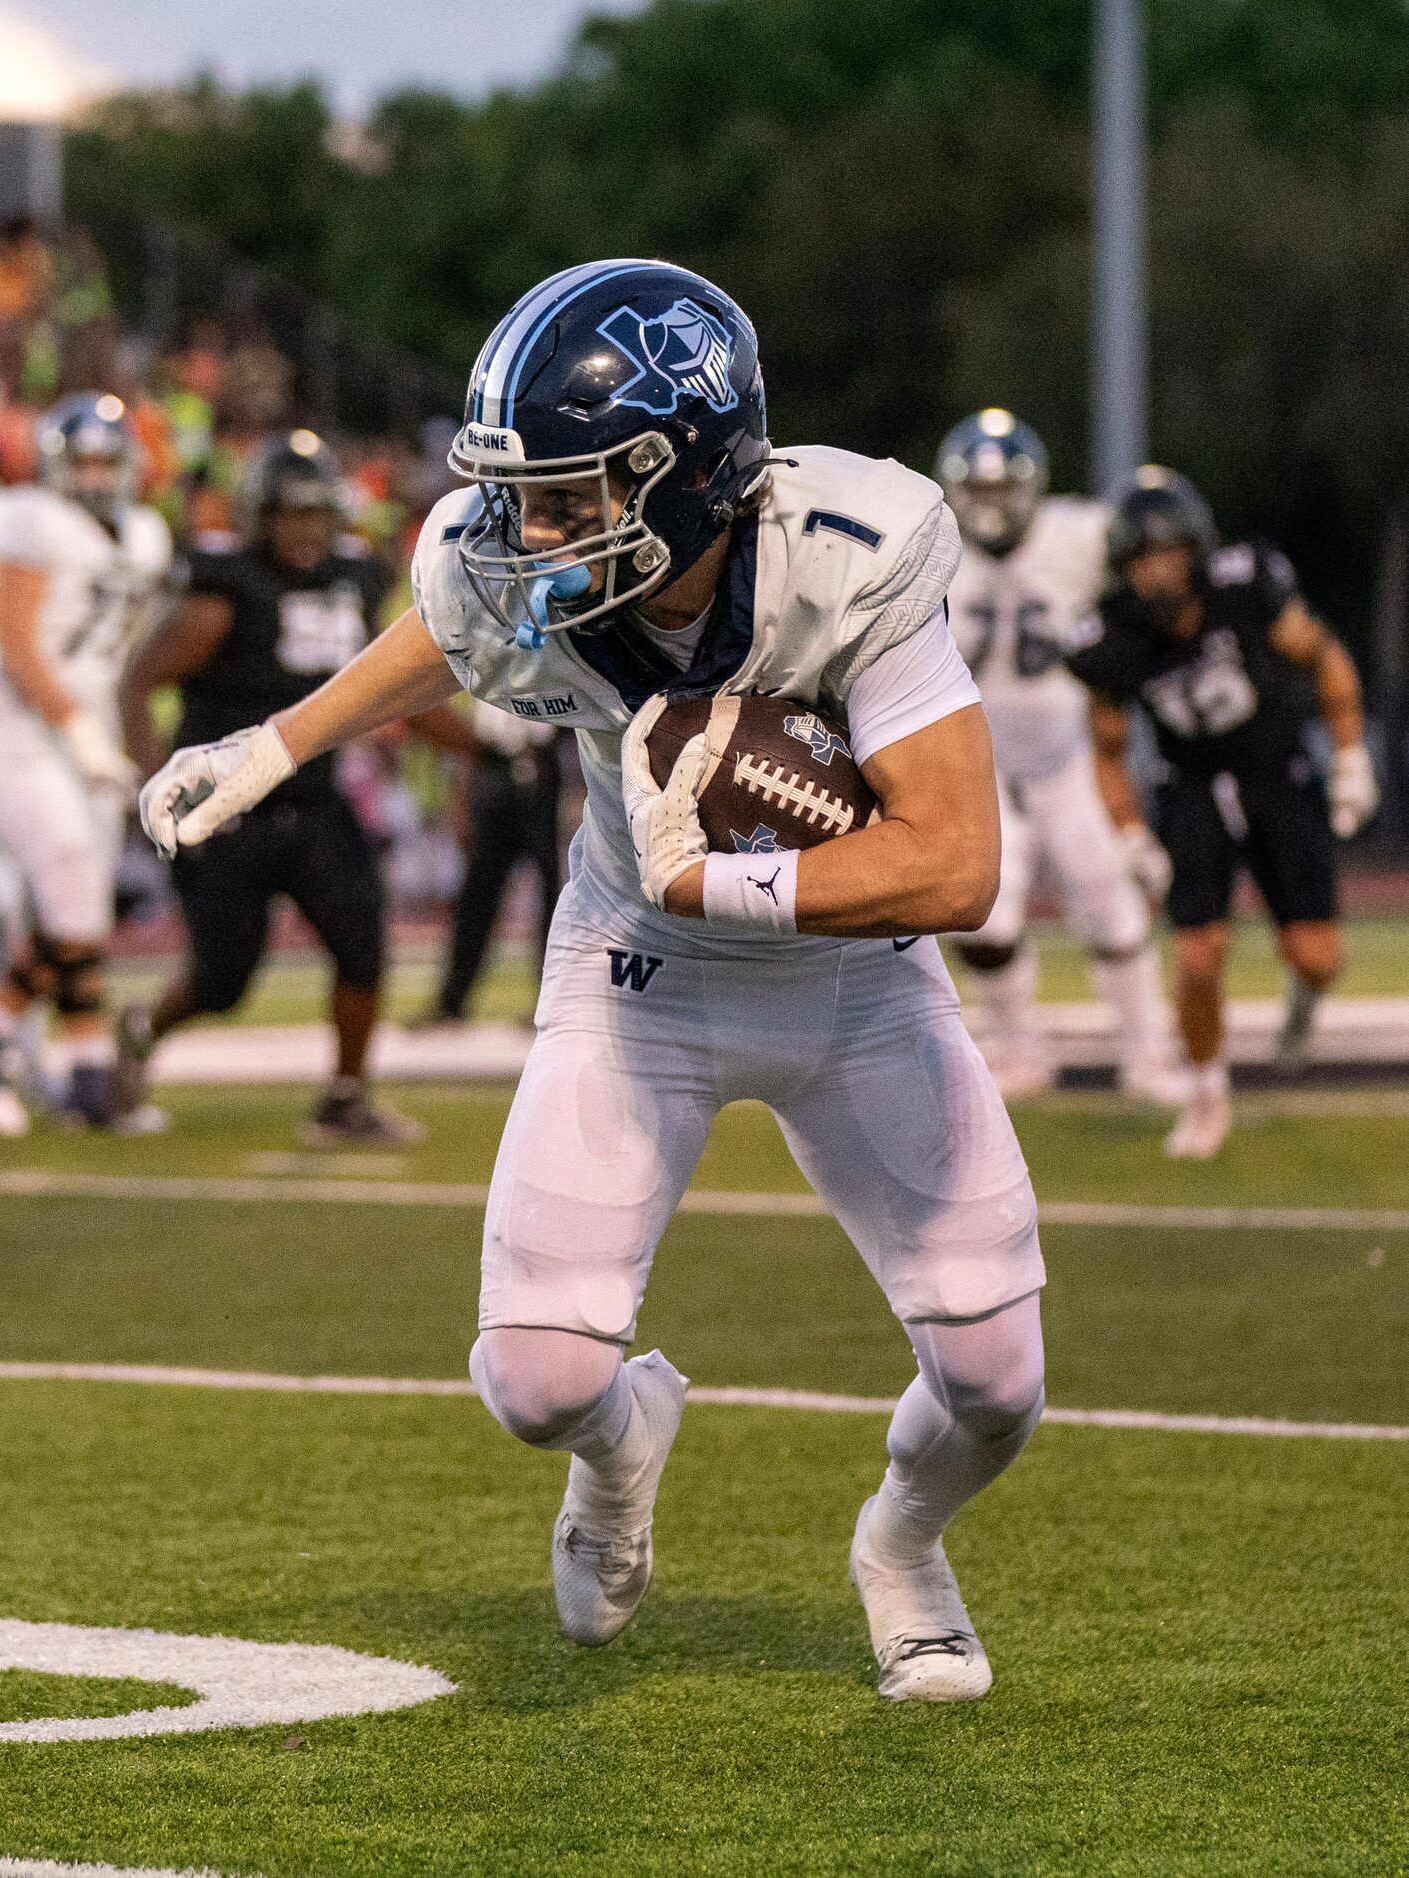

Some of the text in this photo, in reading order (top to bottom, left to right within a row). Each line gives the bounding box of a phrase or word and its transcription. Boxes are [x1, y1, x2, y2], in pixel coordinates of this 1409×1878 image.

[468, 429, 509, 451] BE-ONE
[802, 507, 887, 554] 1
[511, 695, 578, 716] FOR HIM
[606, 949, 664, 992] W
